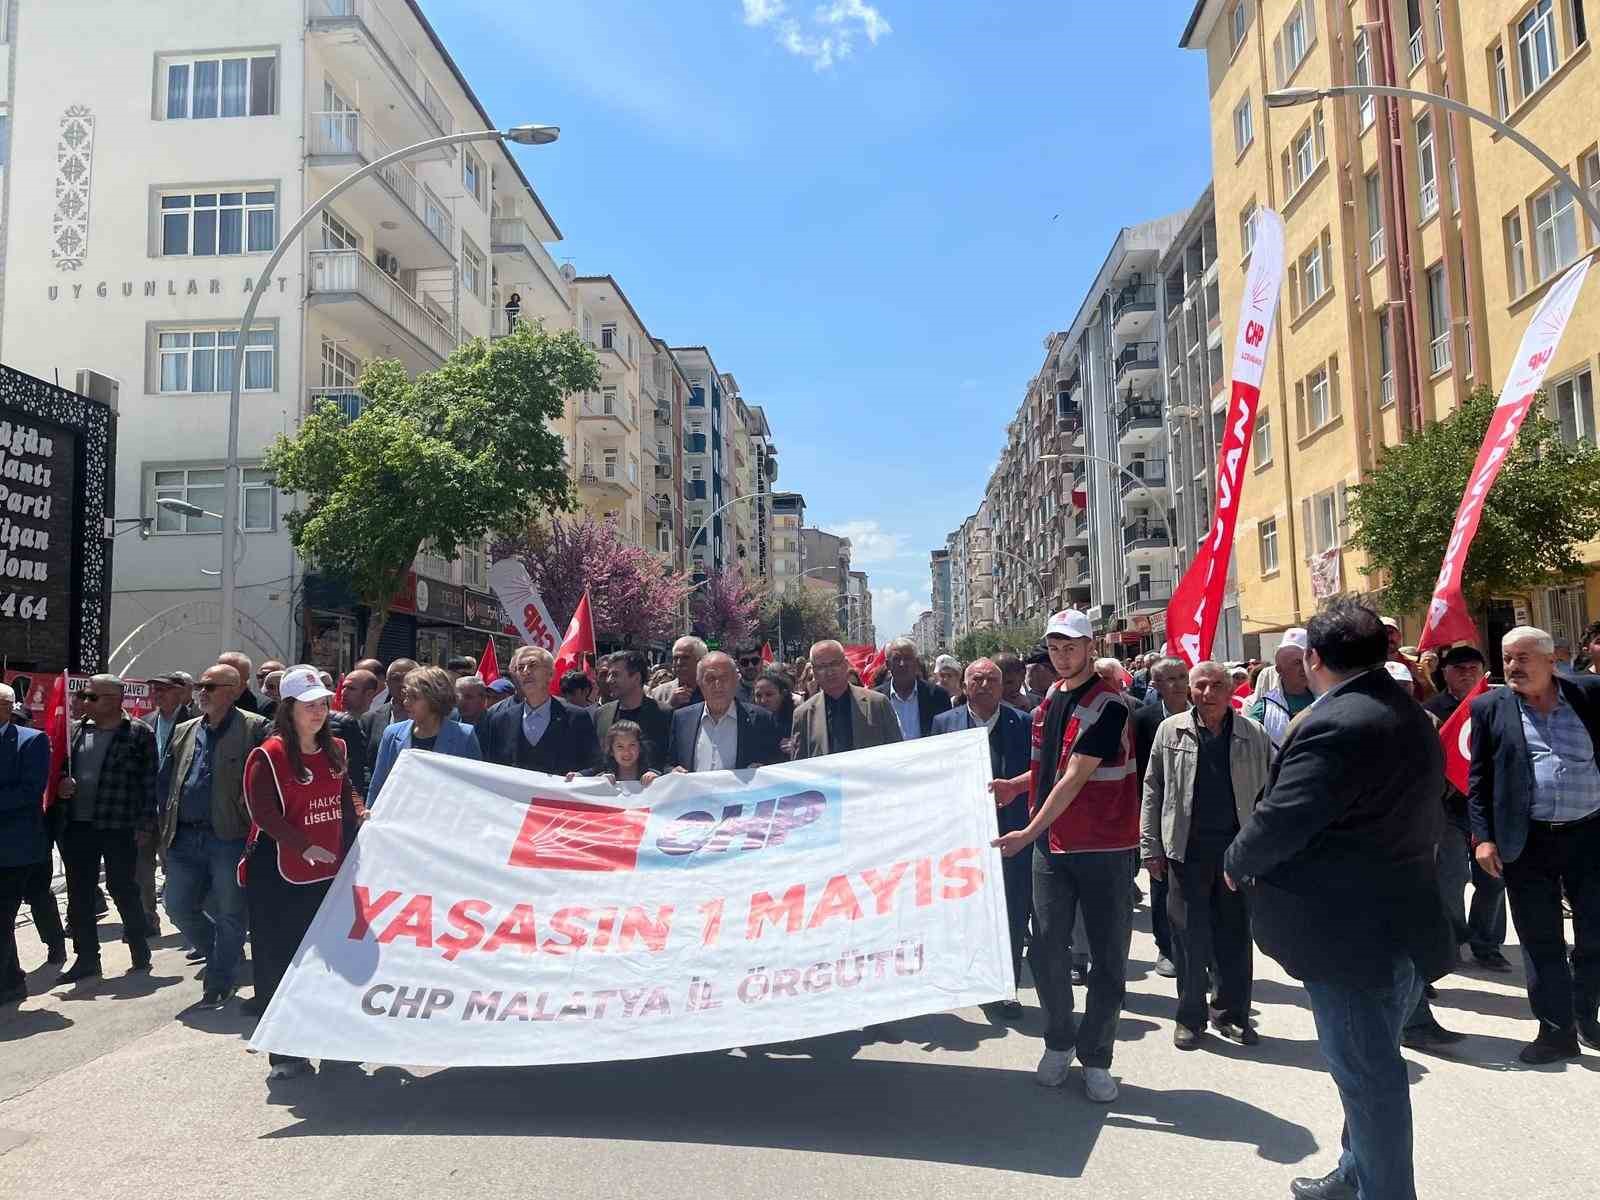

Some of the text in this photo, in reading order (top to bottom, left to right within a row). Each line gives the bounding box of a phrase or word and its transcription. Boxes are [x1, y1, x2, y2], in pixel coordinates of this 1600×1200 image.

[48, 279, 220, 300] UYGUNLAR
[1245, 319, 1264, 347] CHP
[0, 517, 49, 550] işan
[0, 591, 48, 621] 4 64
[656, 790, 827, 856] CHP
[347, 848, 985, 961] YAŞASIN 1 MAYIS
[361, 940, 925, 1022] CHP MALATYA İL ÖRGÜTÜ
